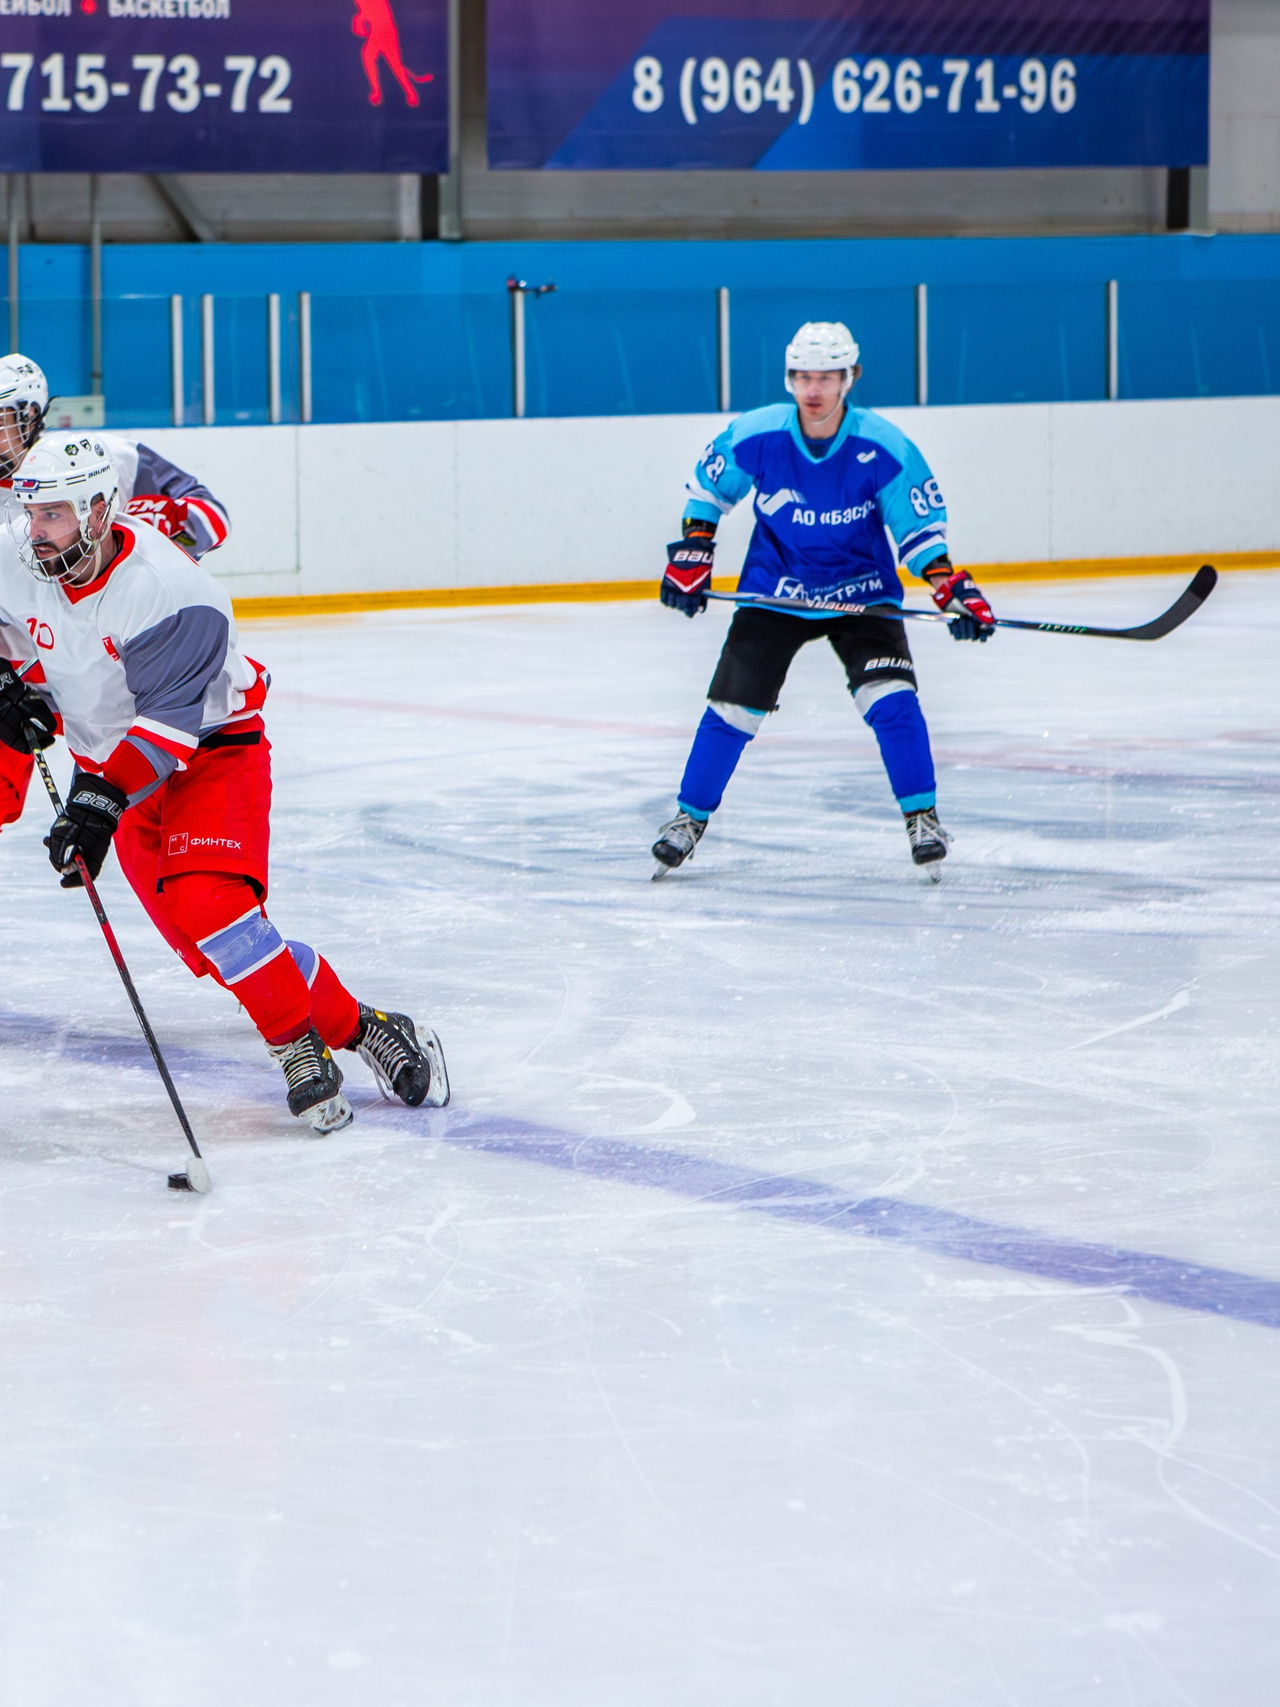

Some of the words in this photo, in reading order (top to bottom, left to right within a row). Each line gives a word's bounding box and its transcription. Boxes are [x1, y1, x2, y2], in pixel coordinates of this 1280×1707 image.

[0, 52, 293, 113] 715-73-72
[632, 55, 664, 112] 8
[679, 57, 815, 125] (964)
[832, 59, 1077, 113] 626-71-96
[909, 477, 946, 517] 88
[792, 508, 815, 526] АО
[26, 617, 55, 651] 10
[190, 837, 242, 850] ФИНТЕХ
